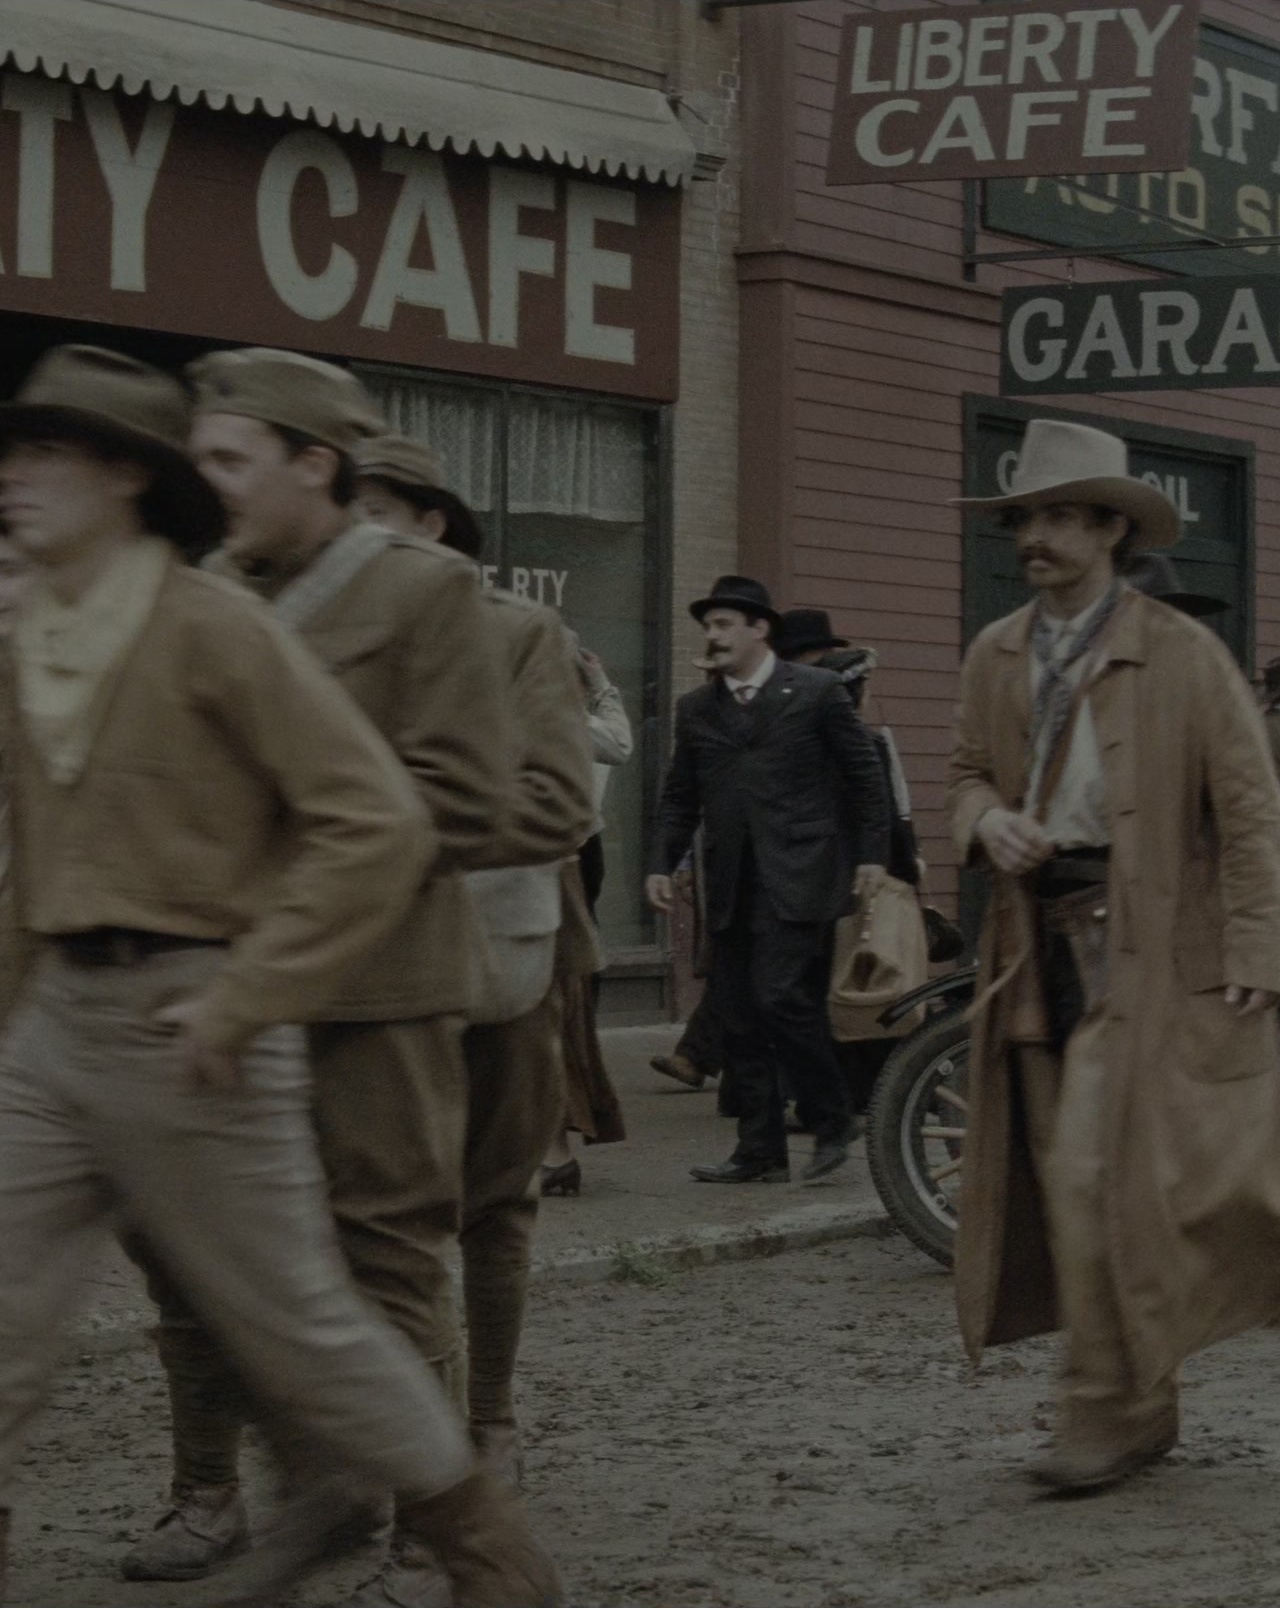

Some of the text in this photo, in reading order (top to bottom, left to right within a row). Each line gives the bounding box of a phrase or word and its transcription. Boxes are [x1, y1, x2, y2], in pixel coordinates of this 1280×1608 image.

[850, 5, 1182, 94] LIBERTY
[855, 86, 1151, 166] CAFE
[257, 128, 635, 365] CAFE
[482, 565, 568, 607] ERTY
